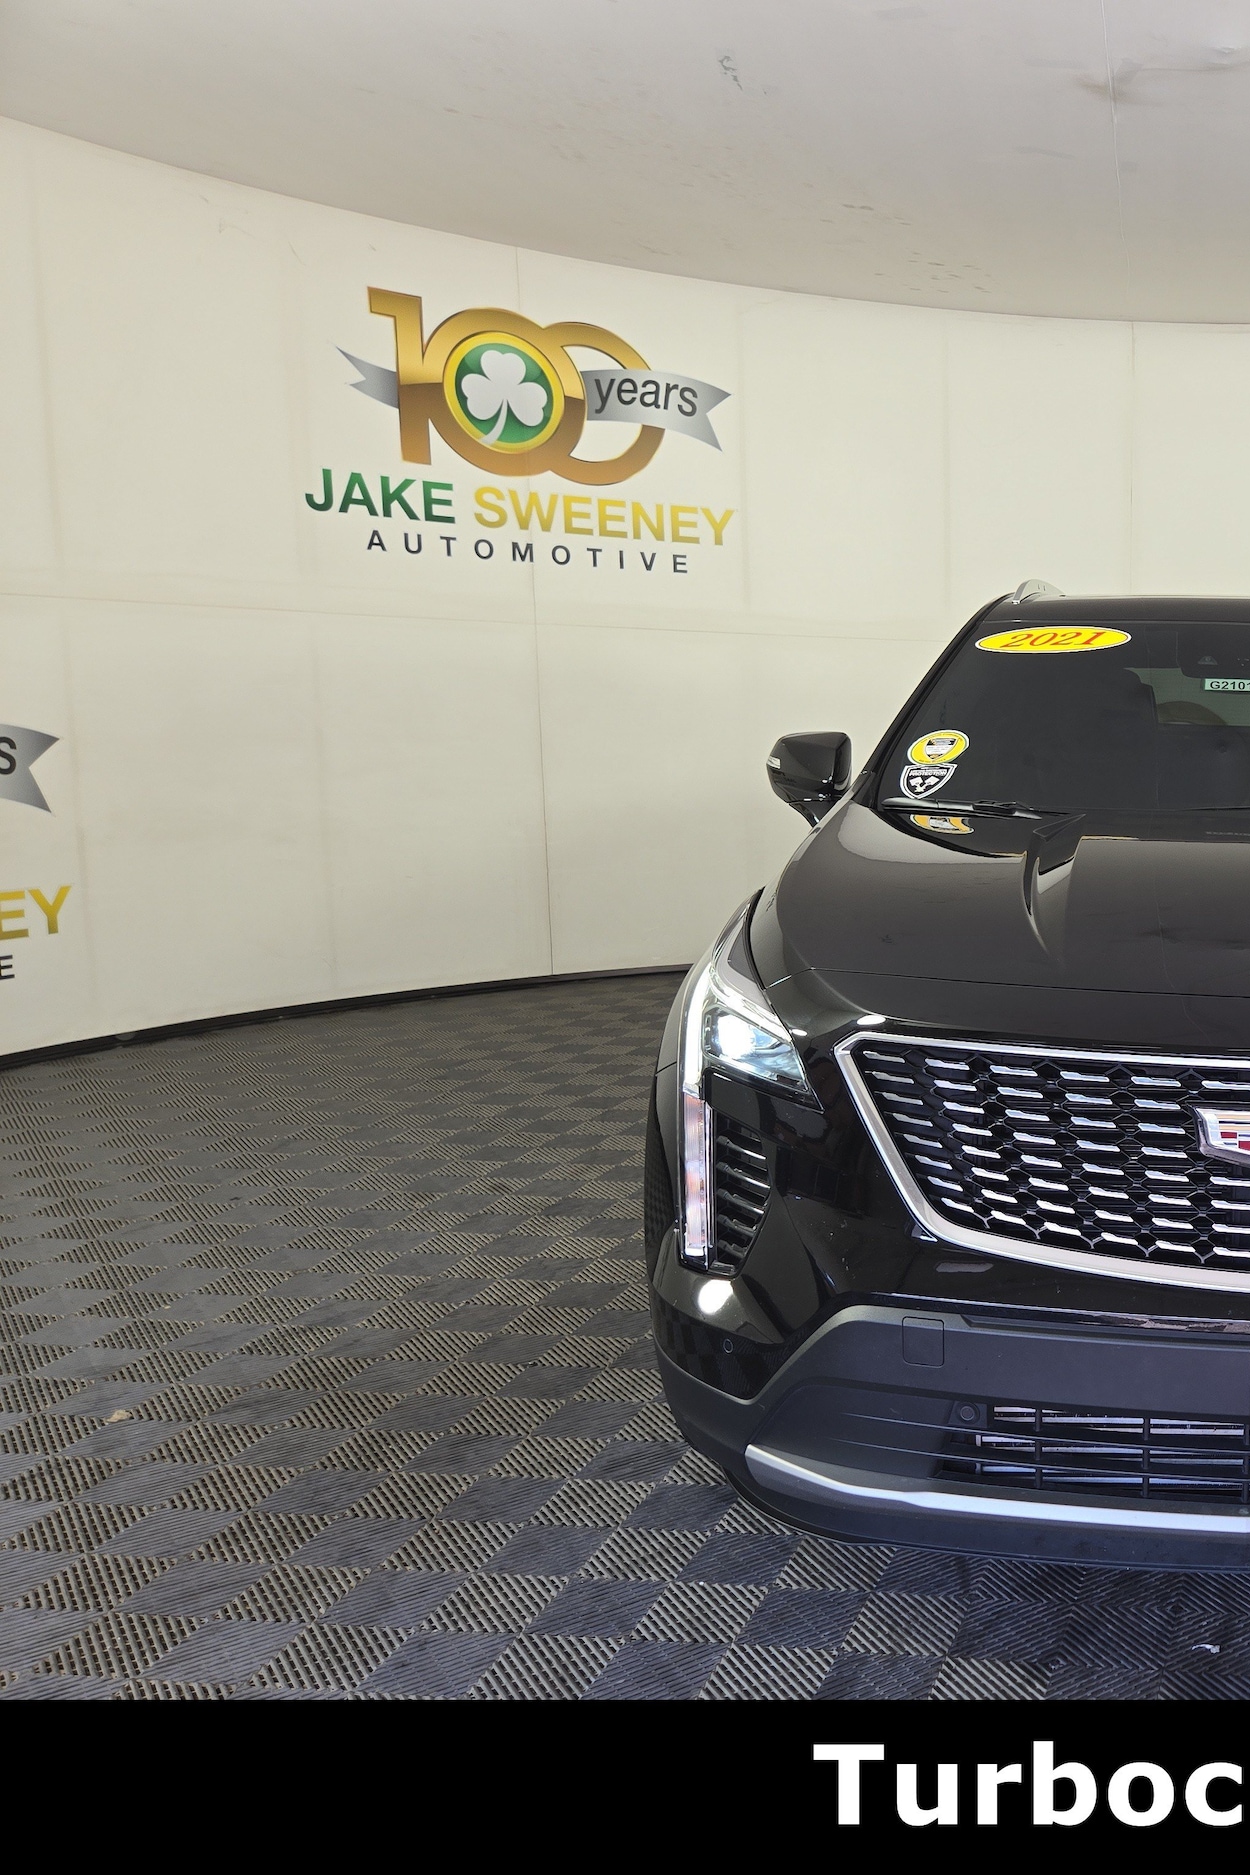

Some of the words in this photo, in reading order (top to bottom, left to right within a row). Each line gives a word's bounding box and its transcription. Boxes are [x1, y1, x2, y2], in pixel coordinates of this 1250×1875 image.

[594, 376, 699, 417] years
[304, 468, 456, 524] JAKE
[474, 486, 736, 546] SWEENEY
[366, 529, 689, 574] AUTOMOTIVE
[1001, 630, 1107, 649] 2021
